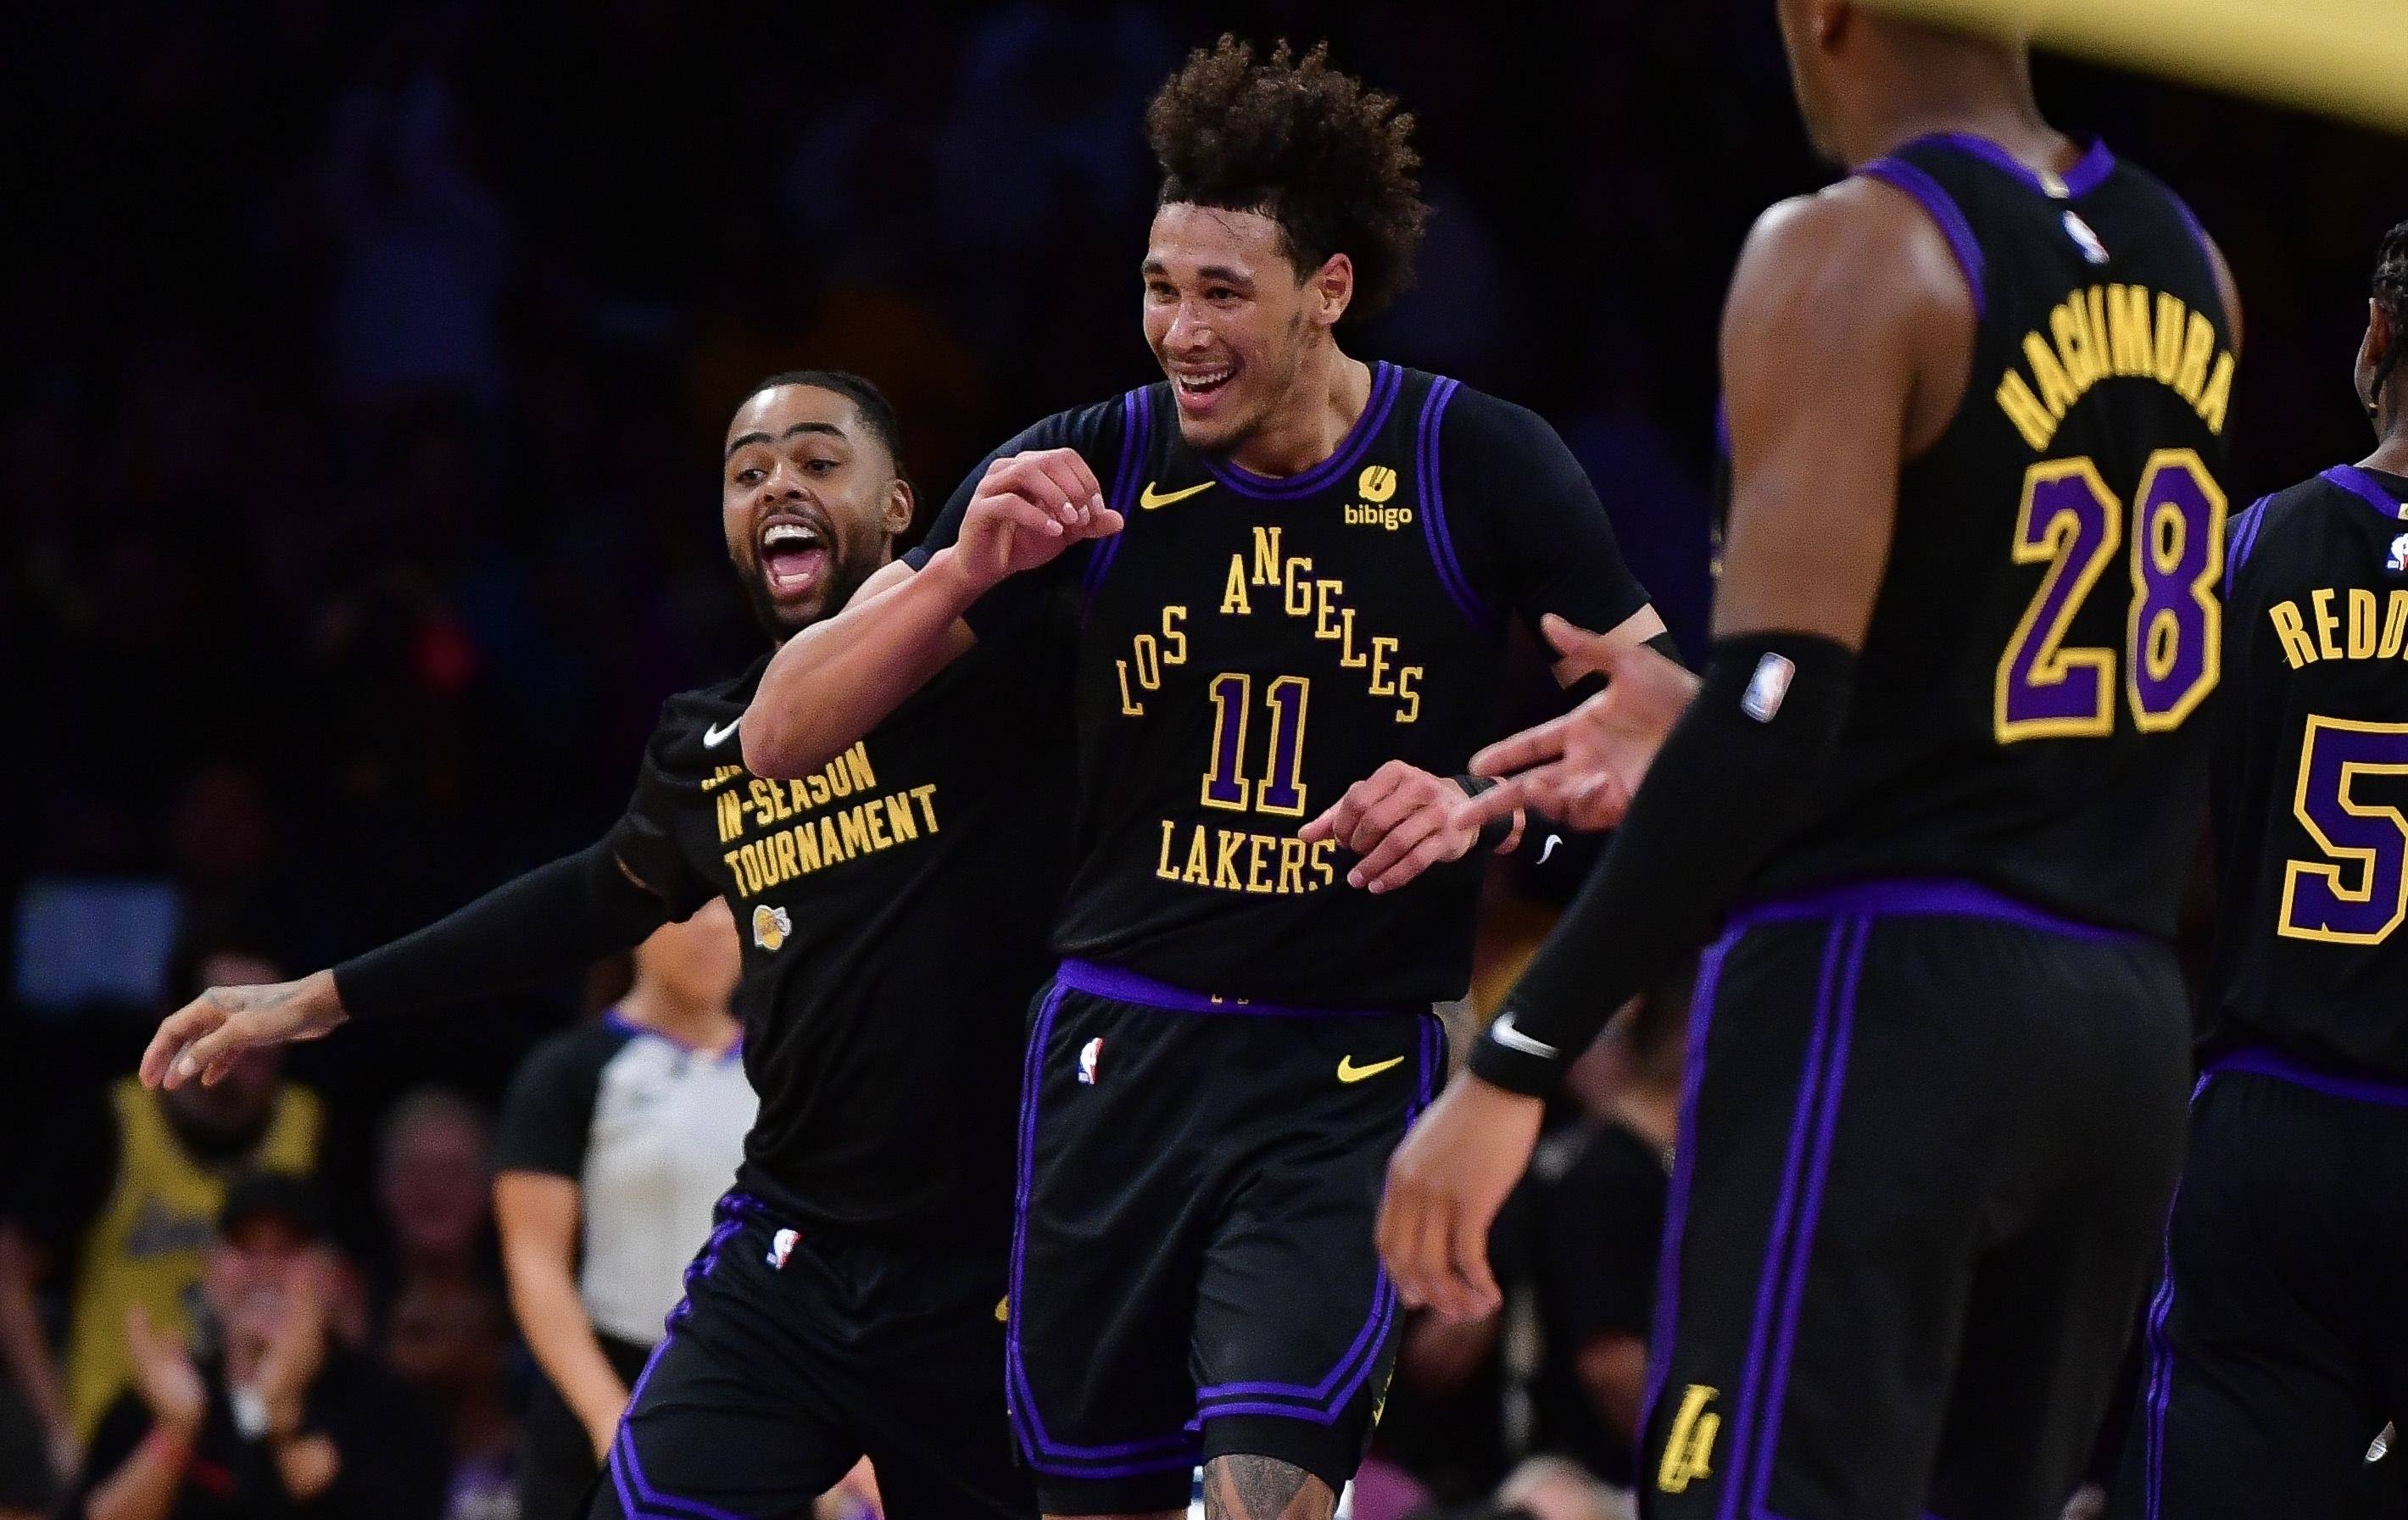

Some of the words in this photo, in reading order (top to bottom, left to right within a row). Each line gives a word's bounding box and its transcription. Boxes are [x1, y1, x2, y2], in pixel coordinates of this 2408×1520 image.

[1344, 504, 1413, 531] bibigo
[1116, 605, 1187, 715] LOS
[1220, 526, 1424, 723] ANGELES
[1993, 447, 2229, 744] 28
[2268, 587, 2408, 670] REDD
[1200, 671, 1310, 817] 11
[723, 782, 940, 899] TOURNAMENT
[1156, 819, 1337, 894] LAKERS
[2277, 713, 2408, 945] 5
